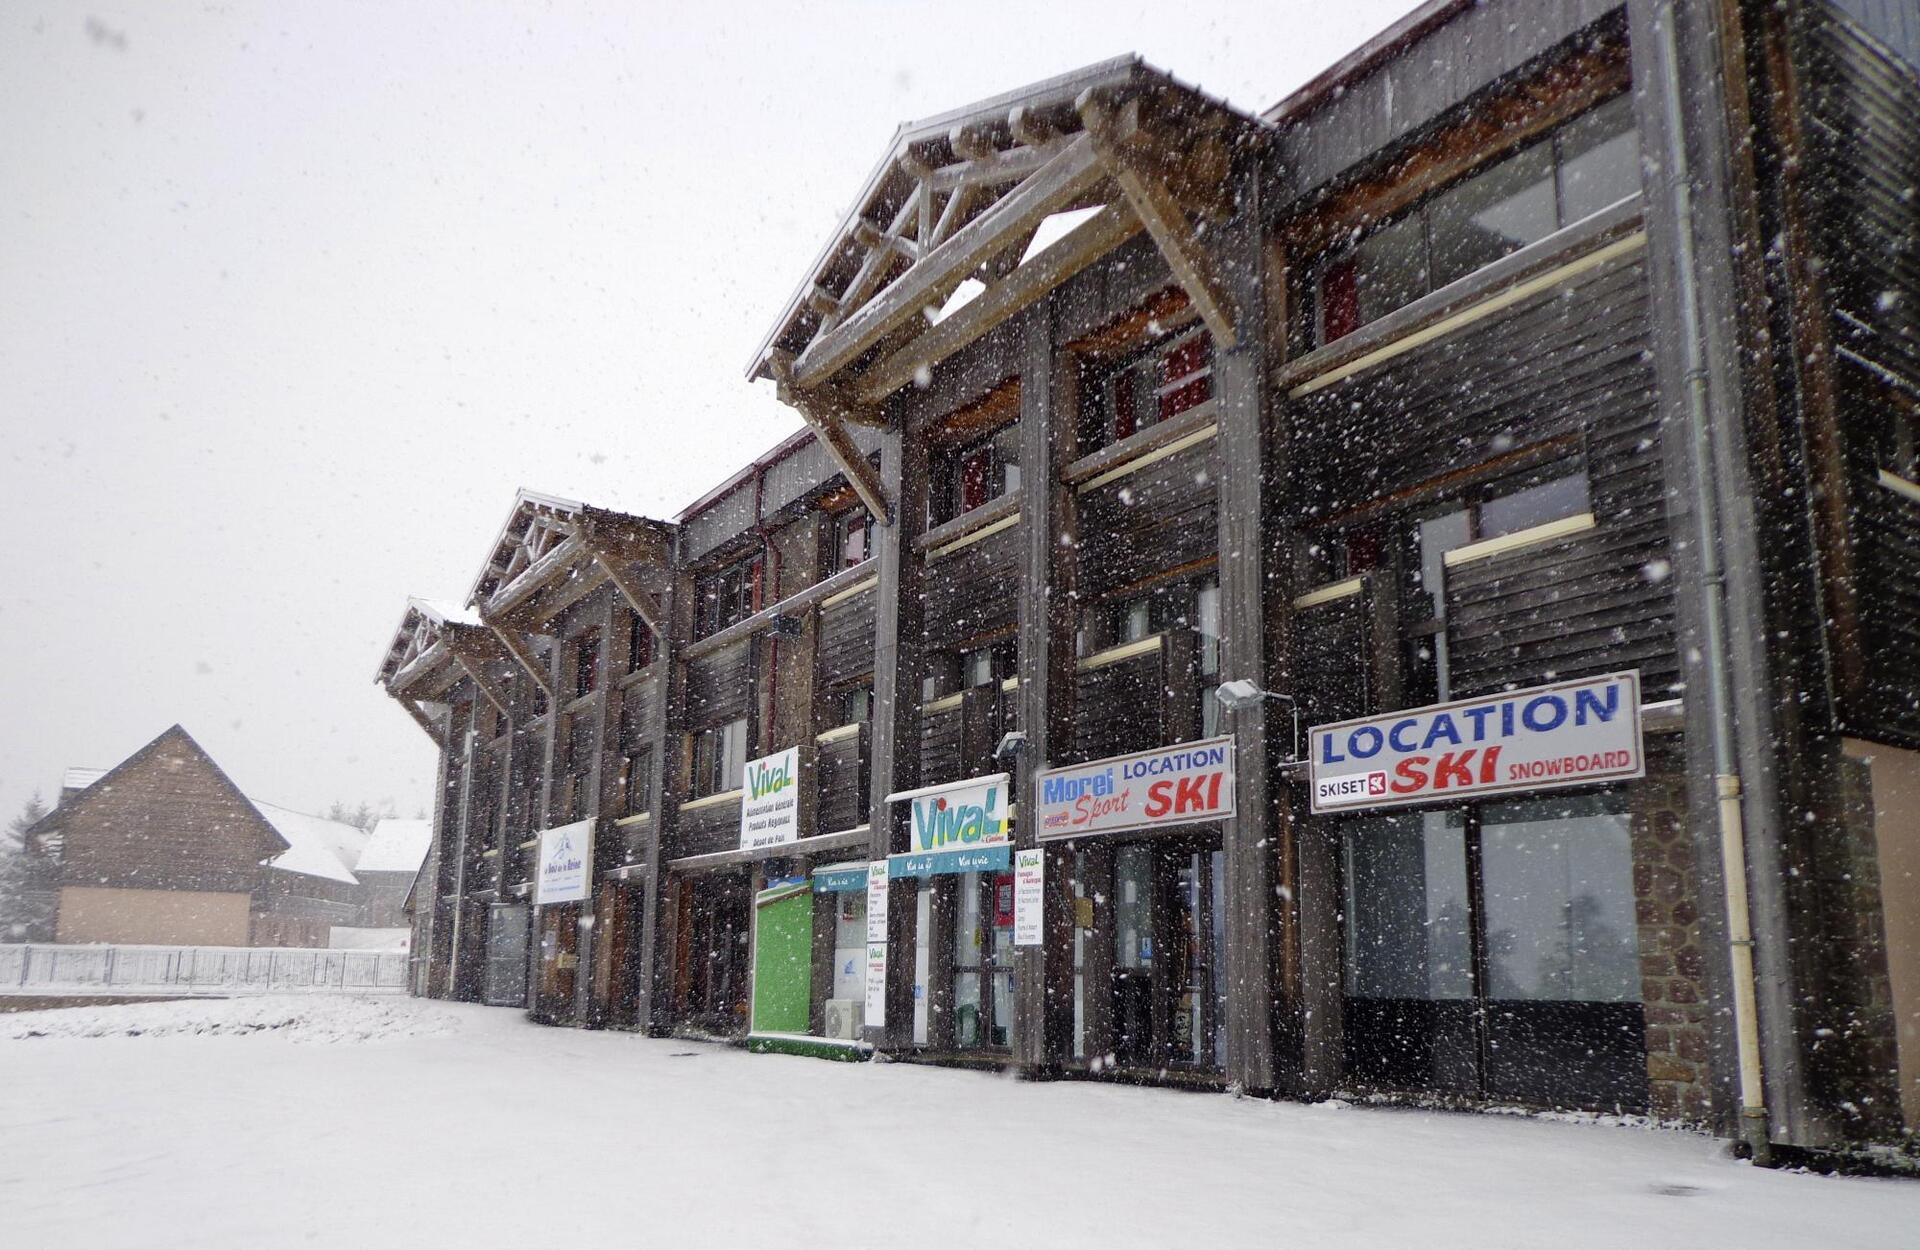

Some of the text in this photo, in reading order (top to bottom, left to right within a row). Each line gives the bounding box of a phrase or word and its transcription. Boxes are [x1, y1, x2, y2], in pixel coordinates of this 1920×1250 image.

[1322, 684, 1620, 764] LOCATION
[1123, 747, 1224, 780] LOCATION
[1391, 745, 1631, 794] SKI SNOWBOARD
[1072, 786, 1130, 827] Sport
[1145, 772, 1223, 818] SKI
[1319, 779, 1366, 798] SKISET
